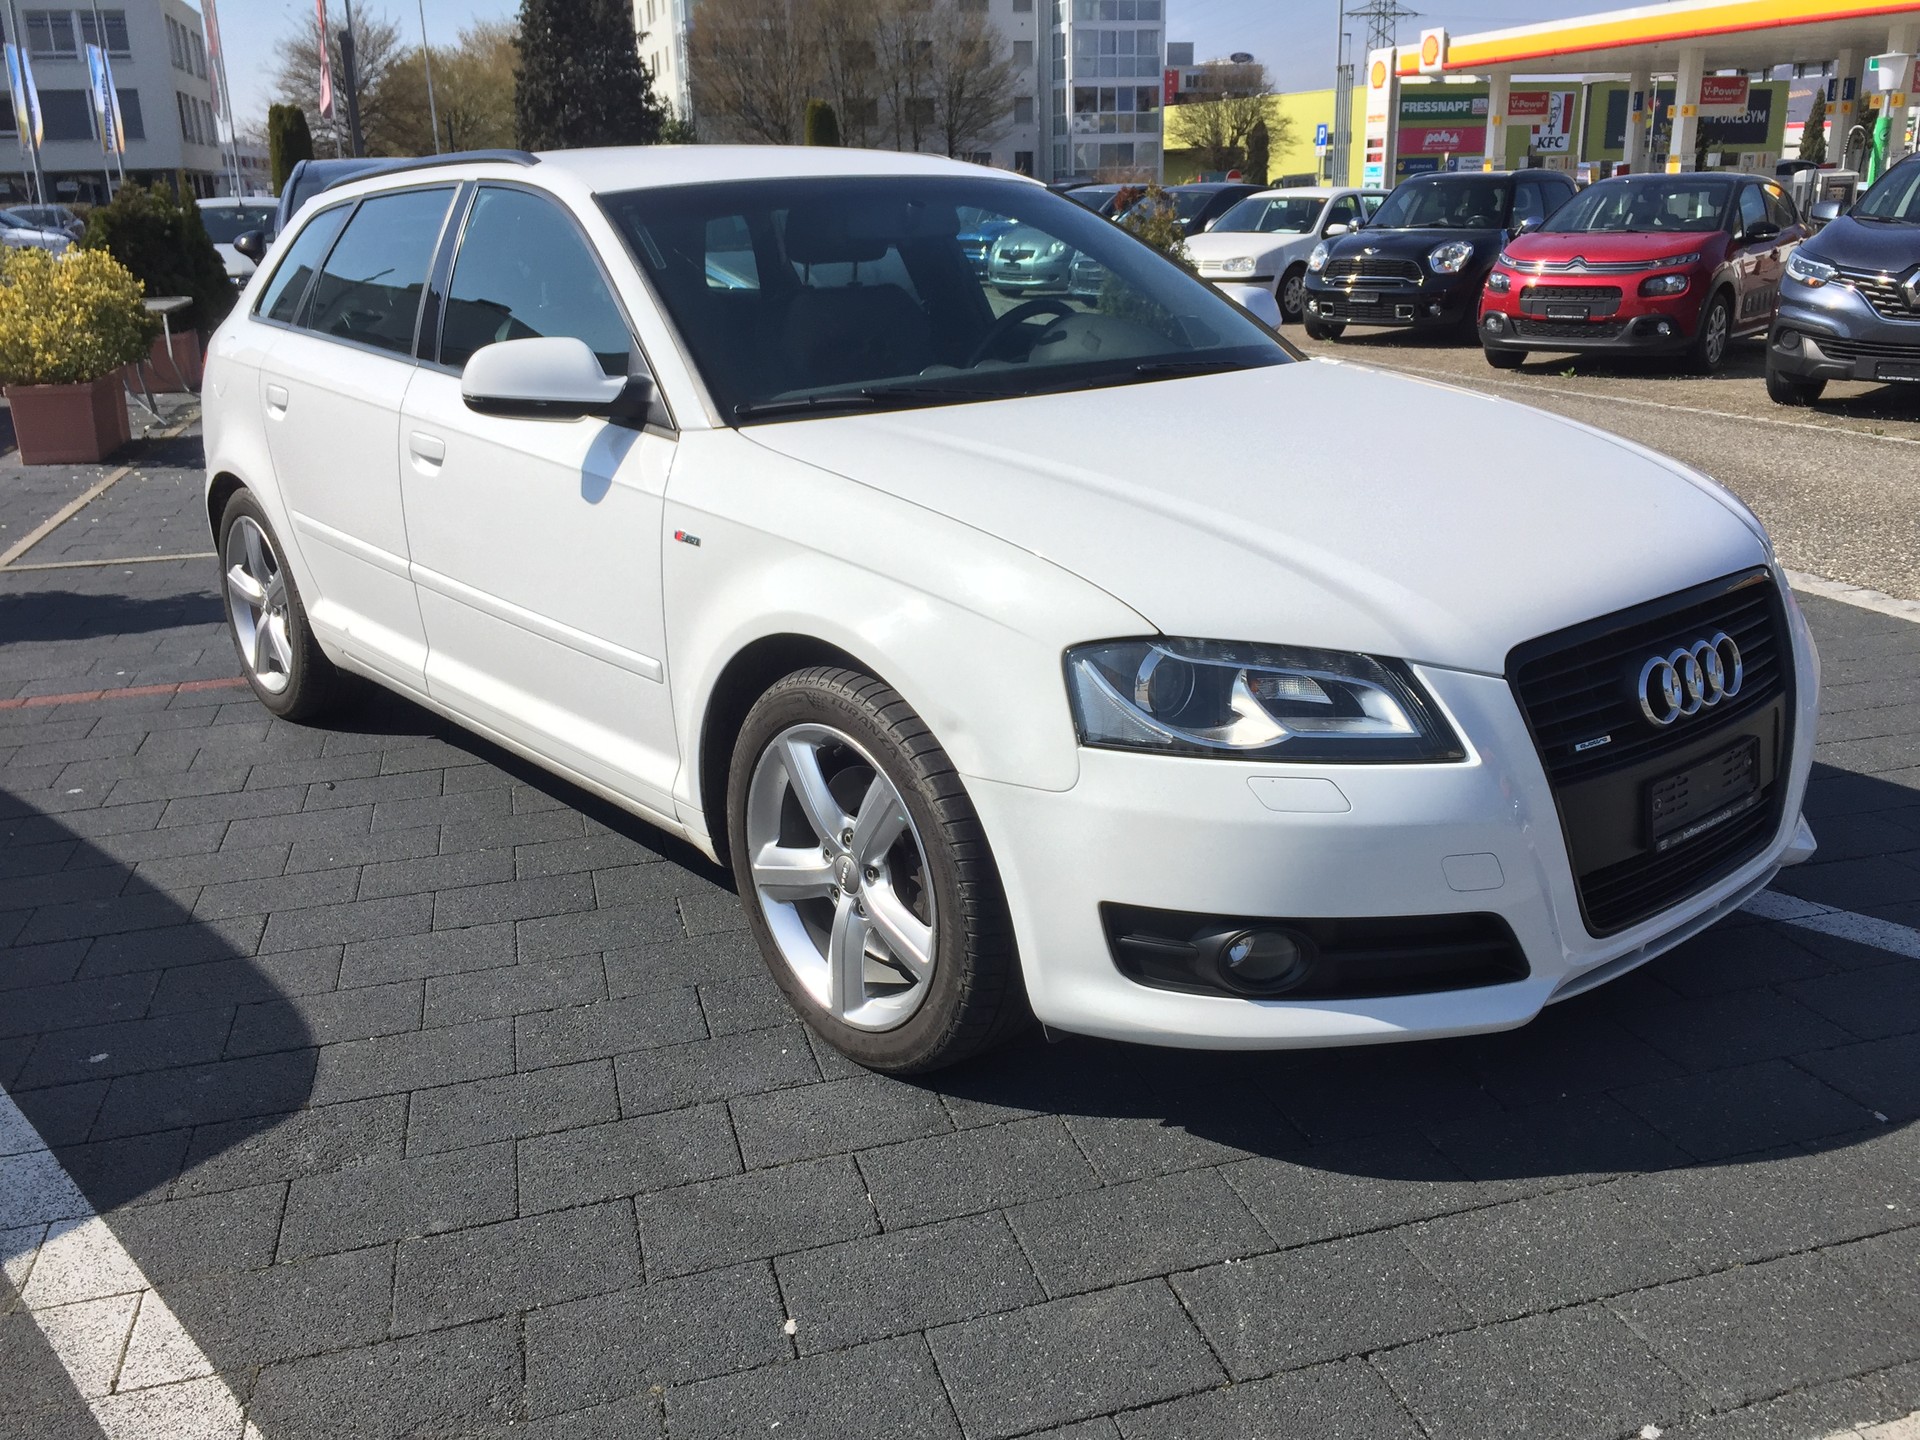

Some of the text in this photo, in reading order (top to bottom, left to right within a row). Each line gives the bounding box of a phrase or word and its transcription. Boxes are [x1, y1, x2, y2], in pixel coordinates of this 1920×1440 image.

[1704, 86, 1742, 96] V-Power
[1402, 101, 1470, 113] FRESSNAPF
[1511, 100, 1544, 108] V-Power
[1318, 126, 1326, 145] P
[1536, 136, 1564, 149] KFC
[831, 696, 898, 760] TURANZA
